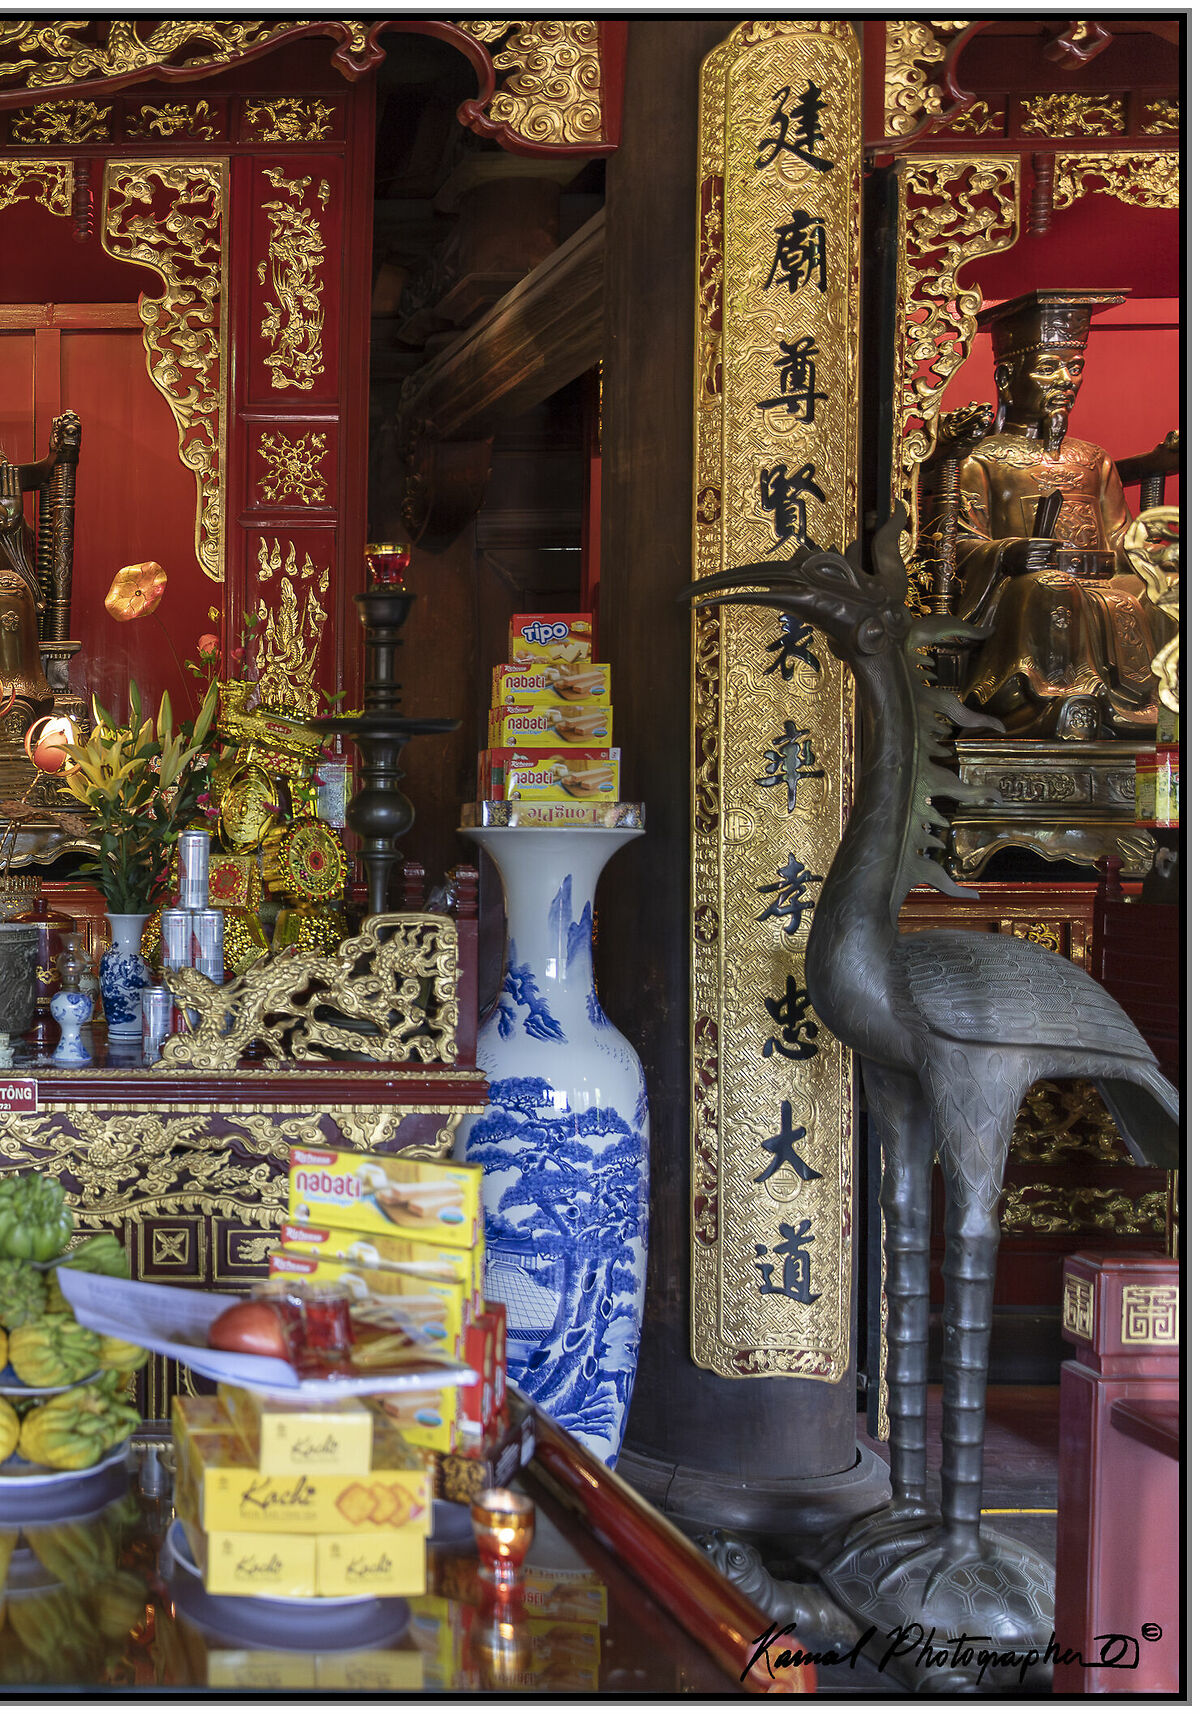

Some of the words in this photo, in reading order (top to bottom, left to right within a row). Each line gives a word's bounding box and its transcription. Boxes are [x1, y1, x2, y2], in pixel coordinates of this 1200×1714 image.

[505, 674, 546, 689] nabati
[507, 715, 548, 730] nabati
[0, 1084, 33, 1100] TÔNG
[295, 1170, 363, 1199] nabati
[240, 1475, 318, 1509] Kachi
